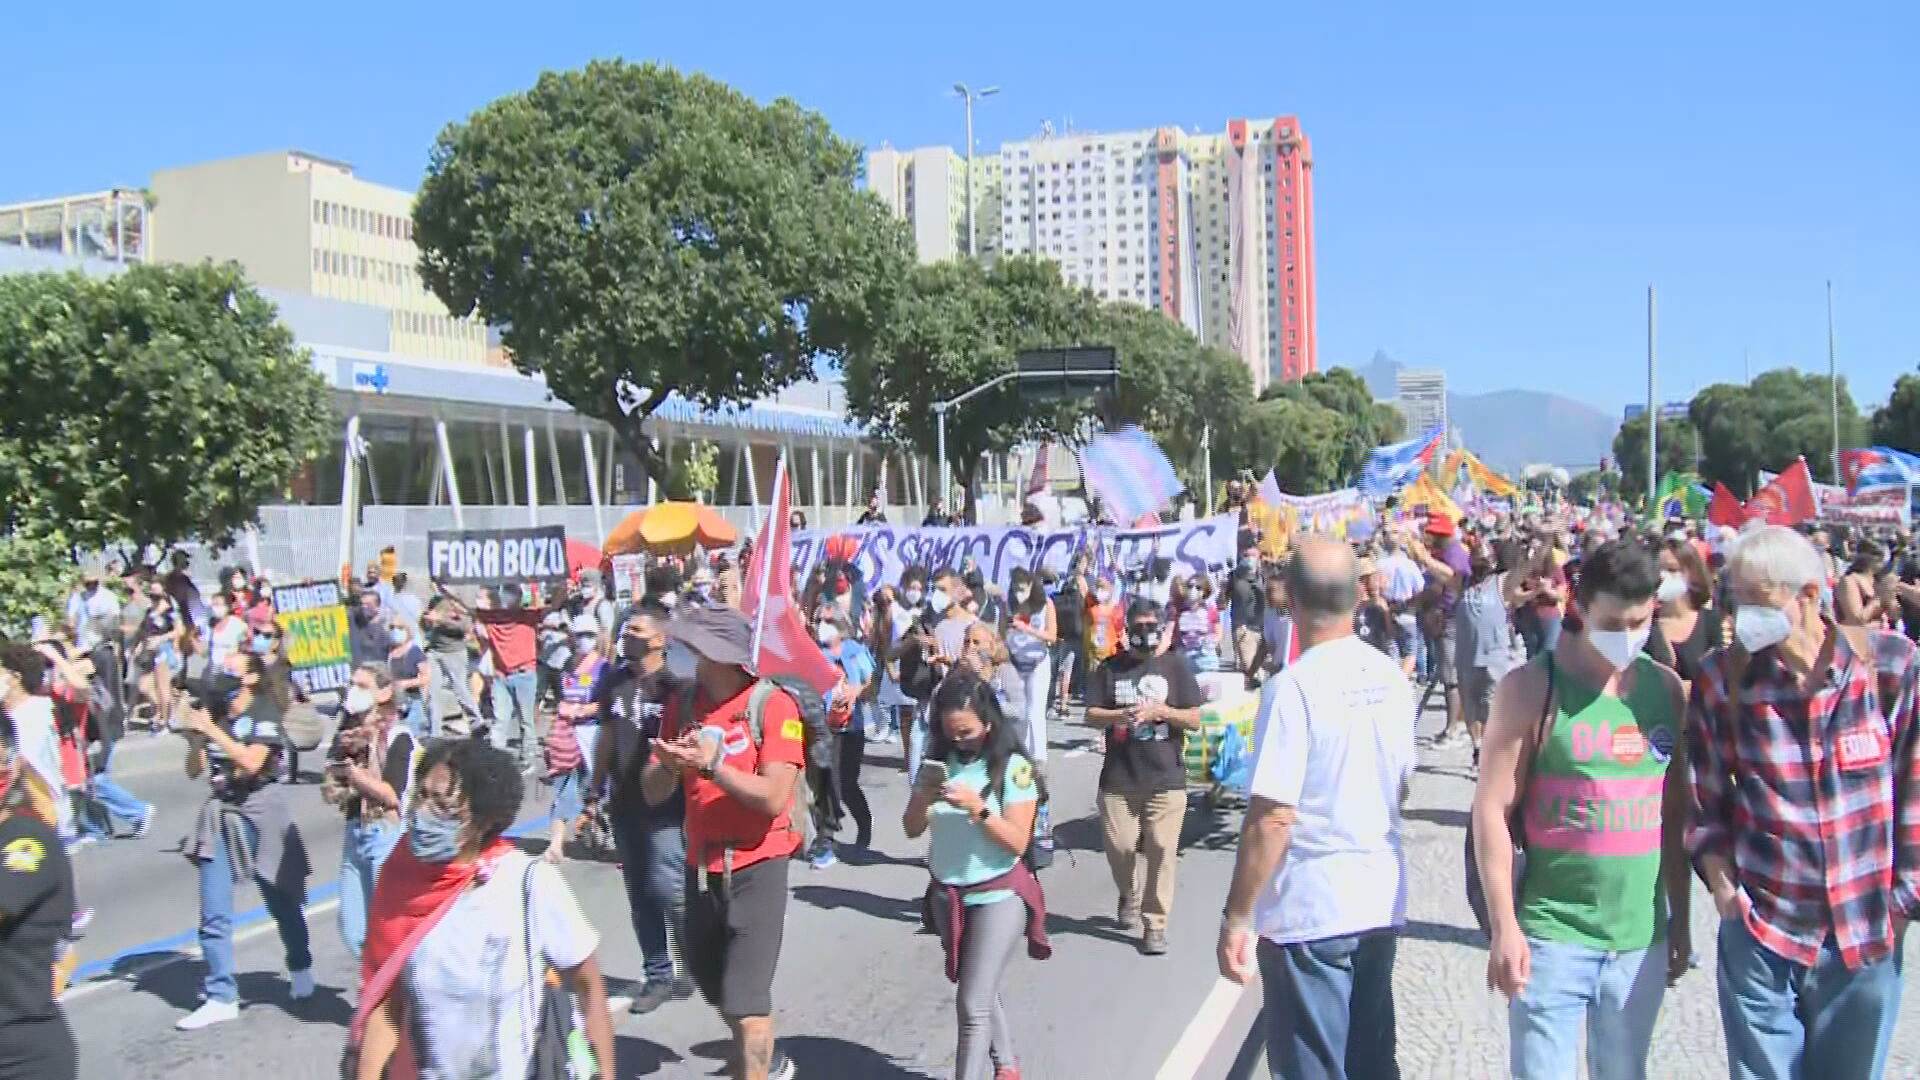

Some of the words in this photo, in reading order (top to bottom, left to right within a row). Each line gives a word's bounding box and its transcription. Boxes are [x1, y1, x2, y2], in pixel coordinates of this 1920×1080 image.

[432, 539, 500, 577] FORA
[503, 537, 565, 577] BOZO
[288, 612, 337, 640] MEU
